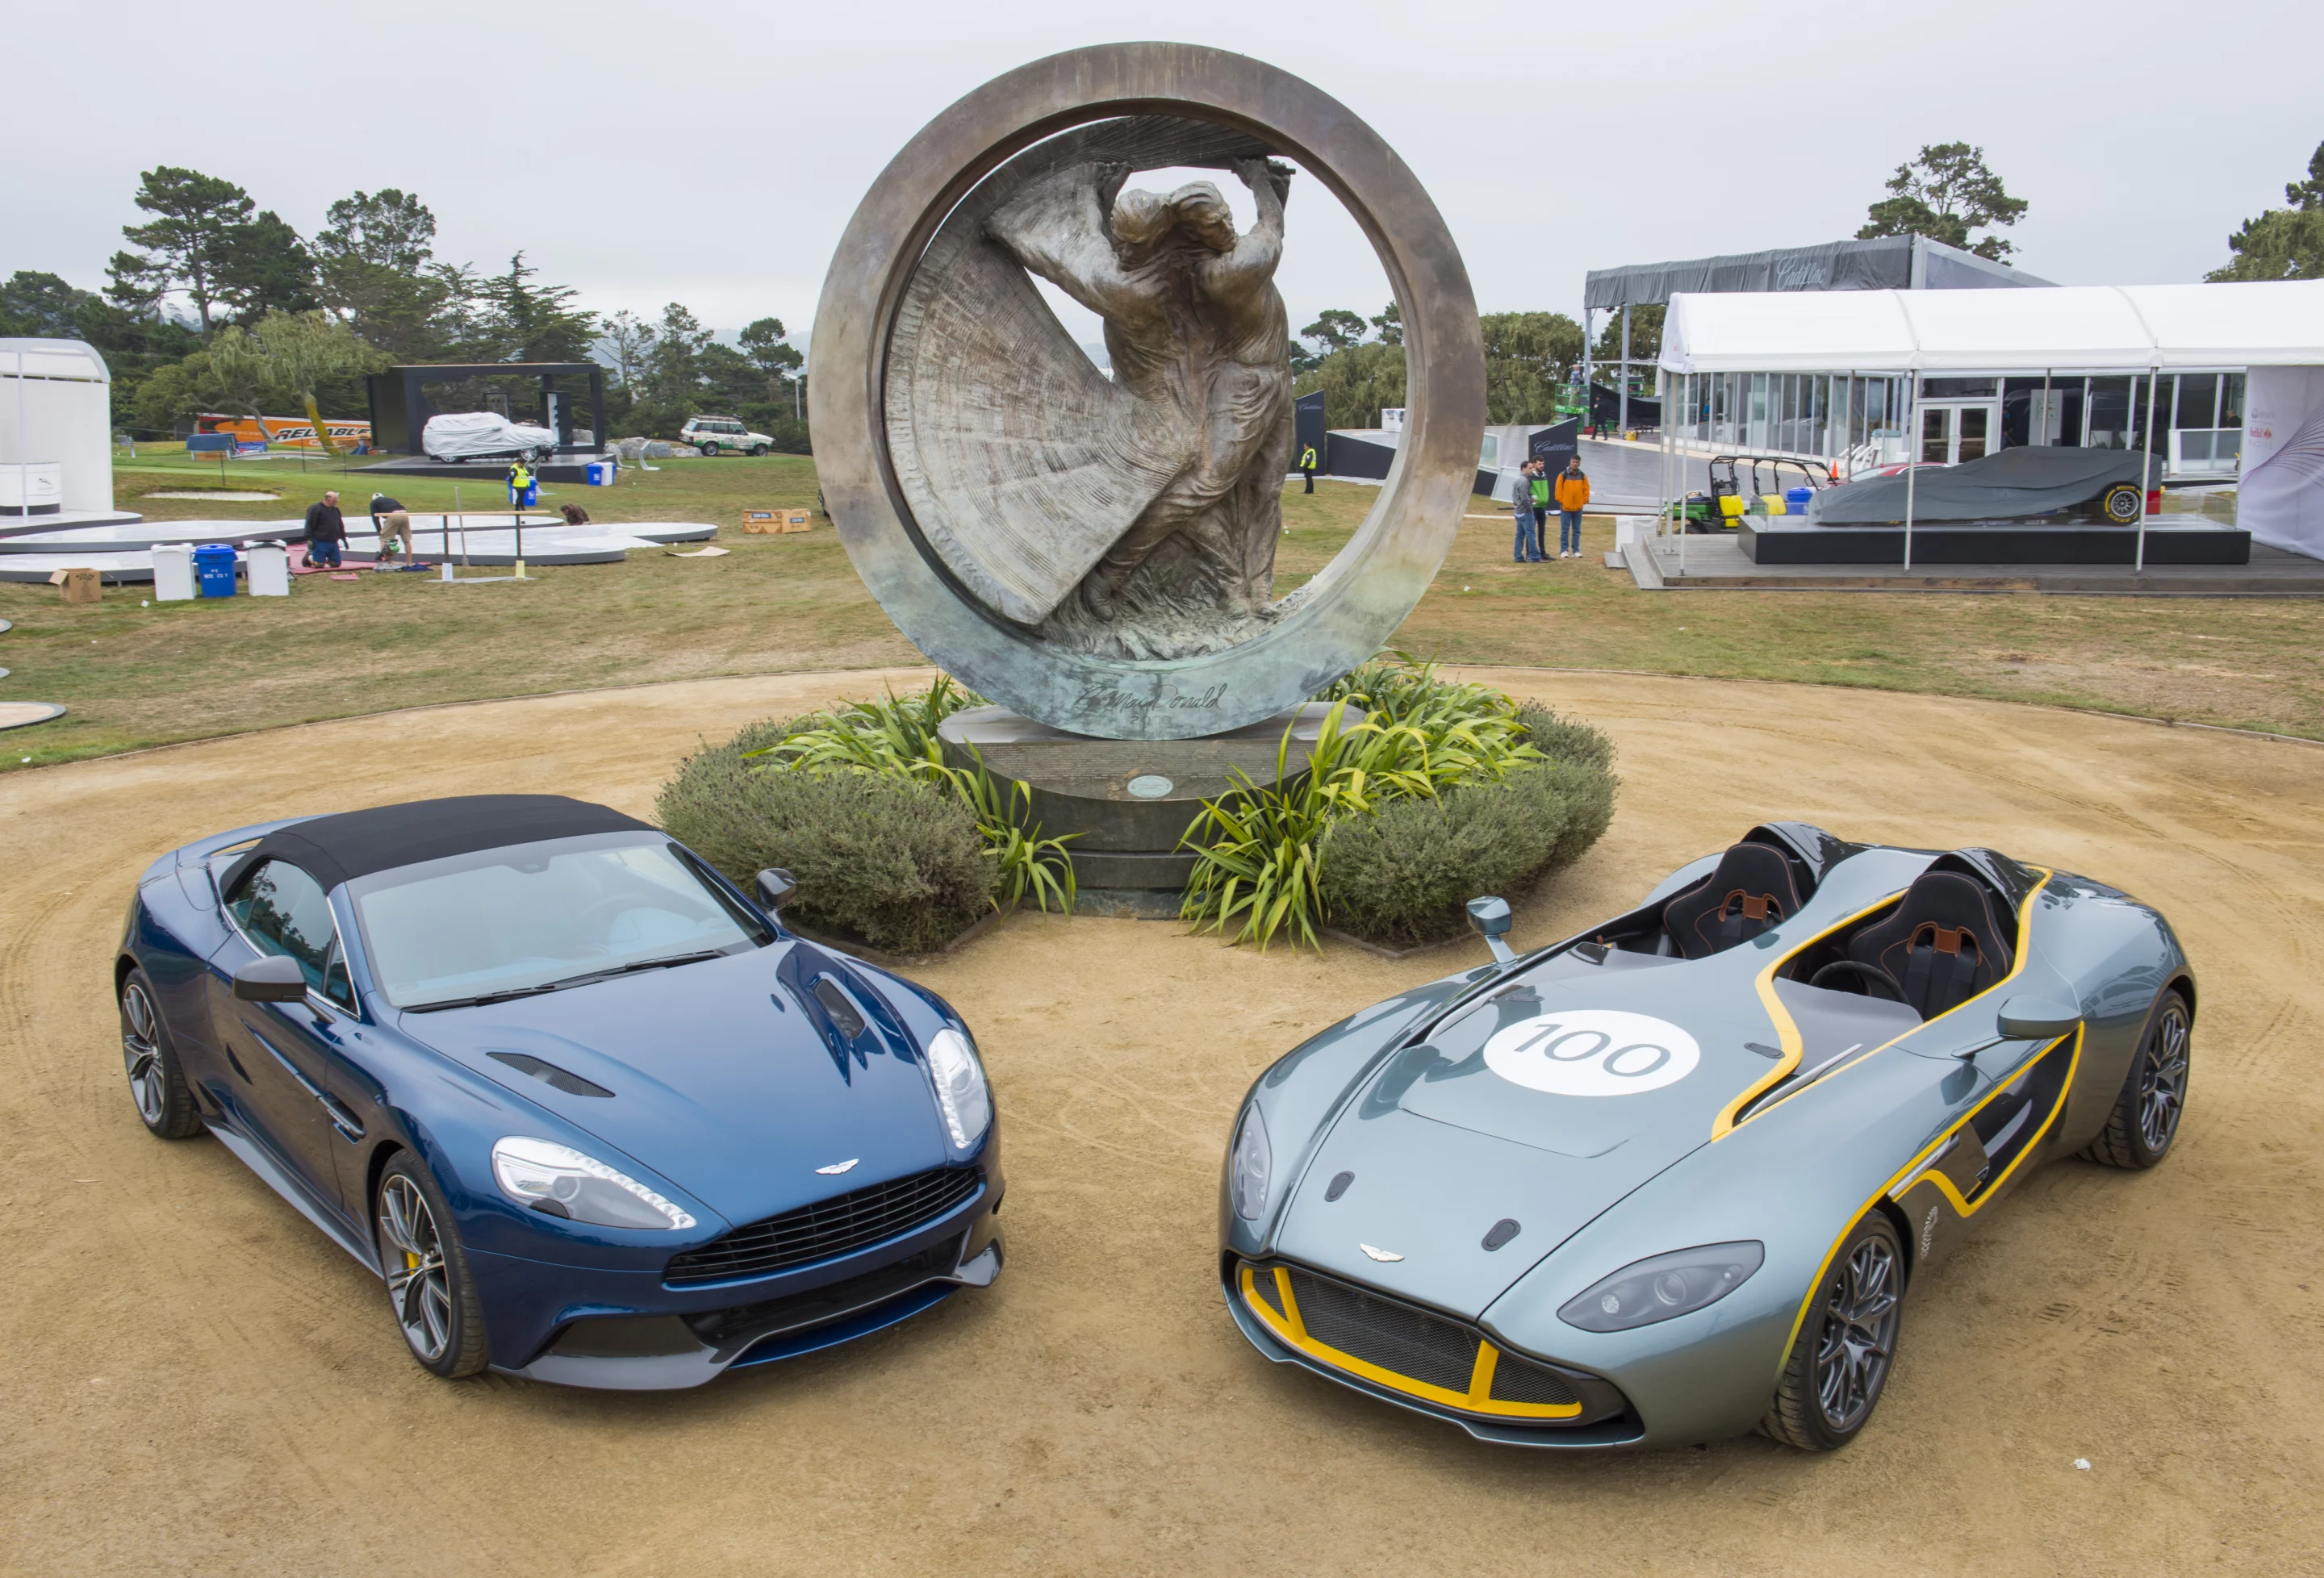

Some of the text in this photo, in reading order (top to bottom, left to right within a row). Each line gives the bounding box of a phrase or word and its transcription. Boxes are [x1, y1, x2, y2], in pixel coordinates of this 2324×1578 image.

[1777, 255, 1826, 290] Cadillac
[275, 426, 370, 441] RELABLE
[1534, 440, 1574, 453] Cadillac
[1514, 1023, 1670, 1077] 100
